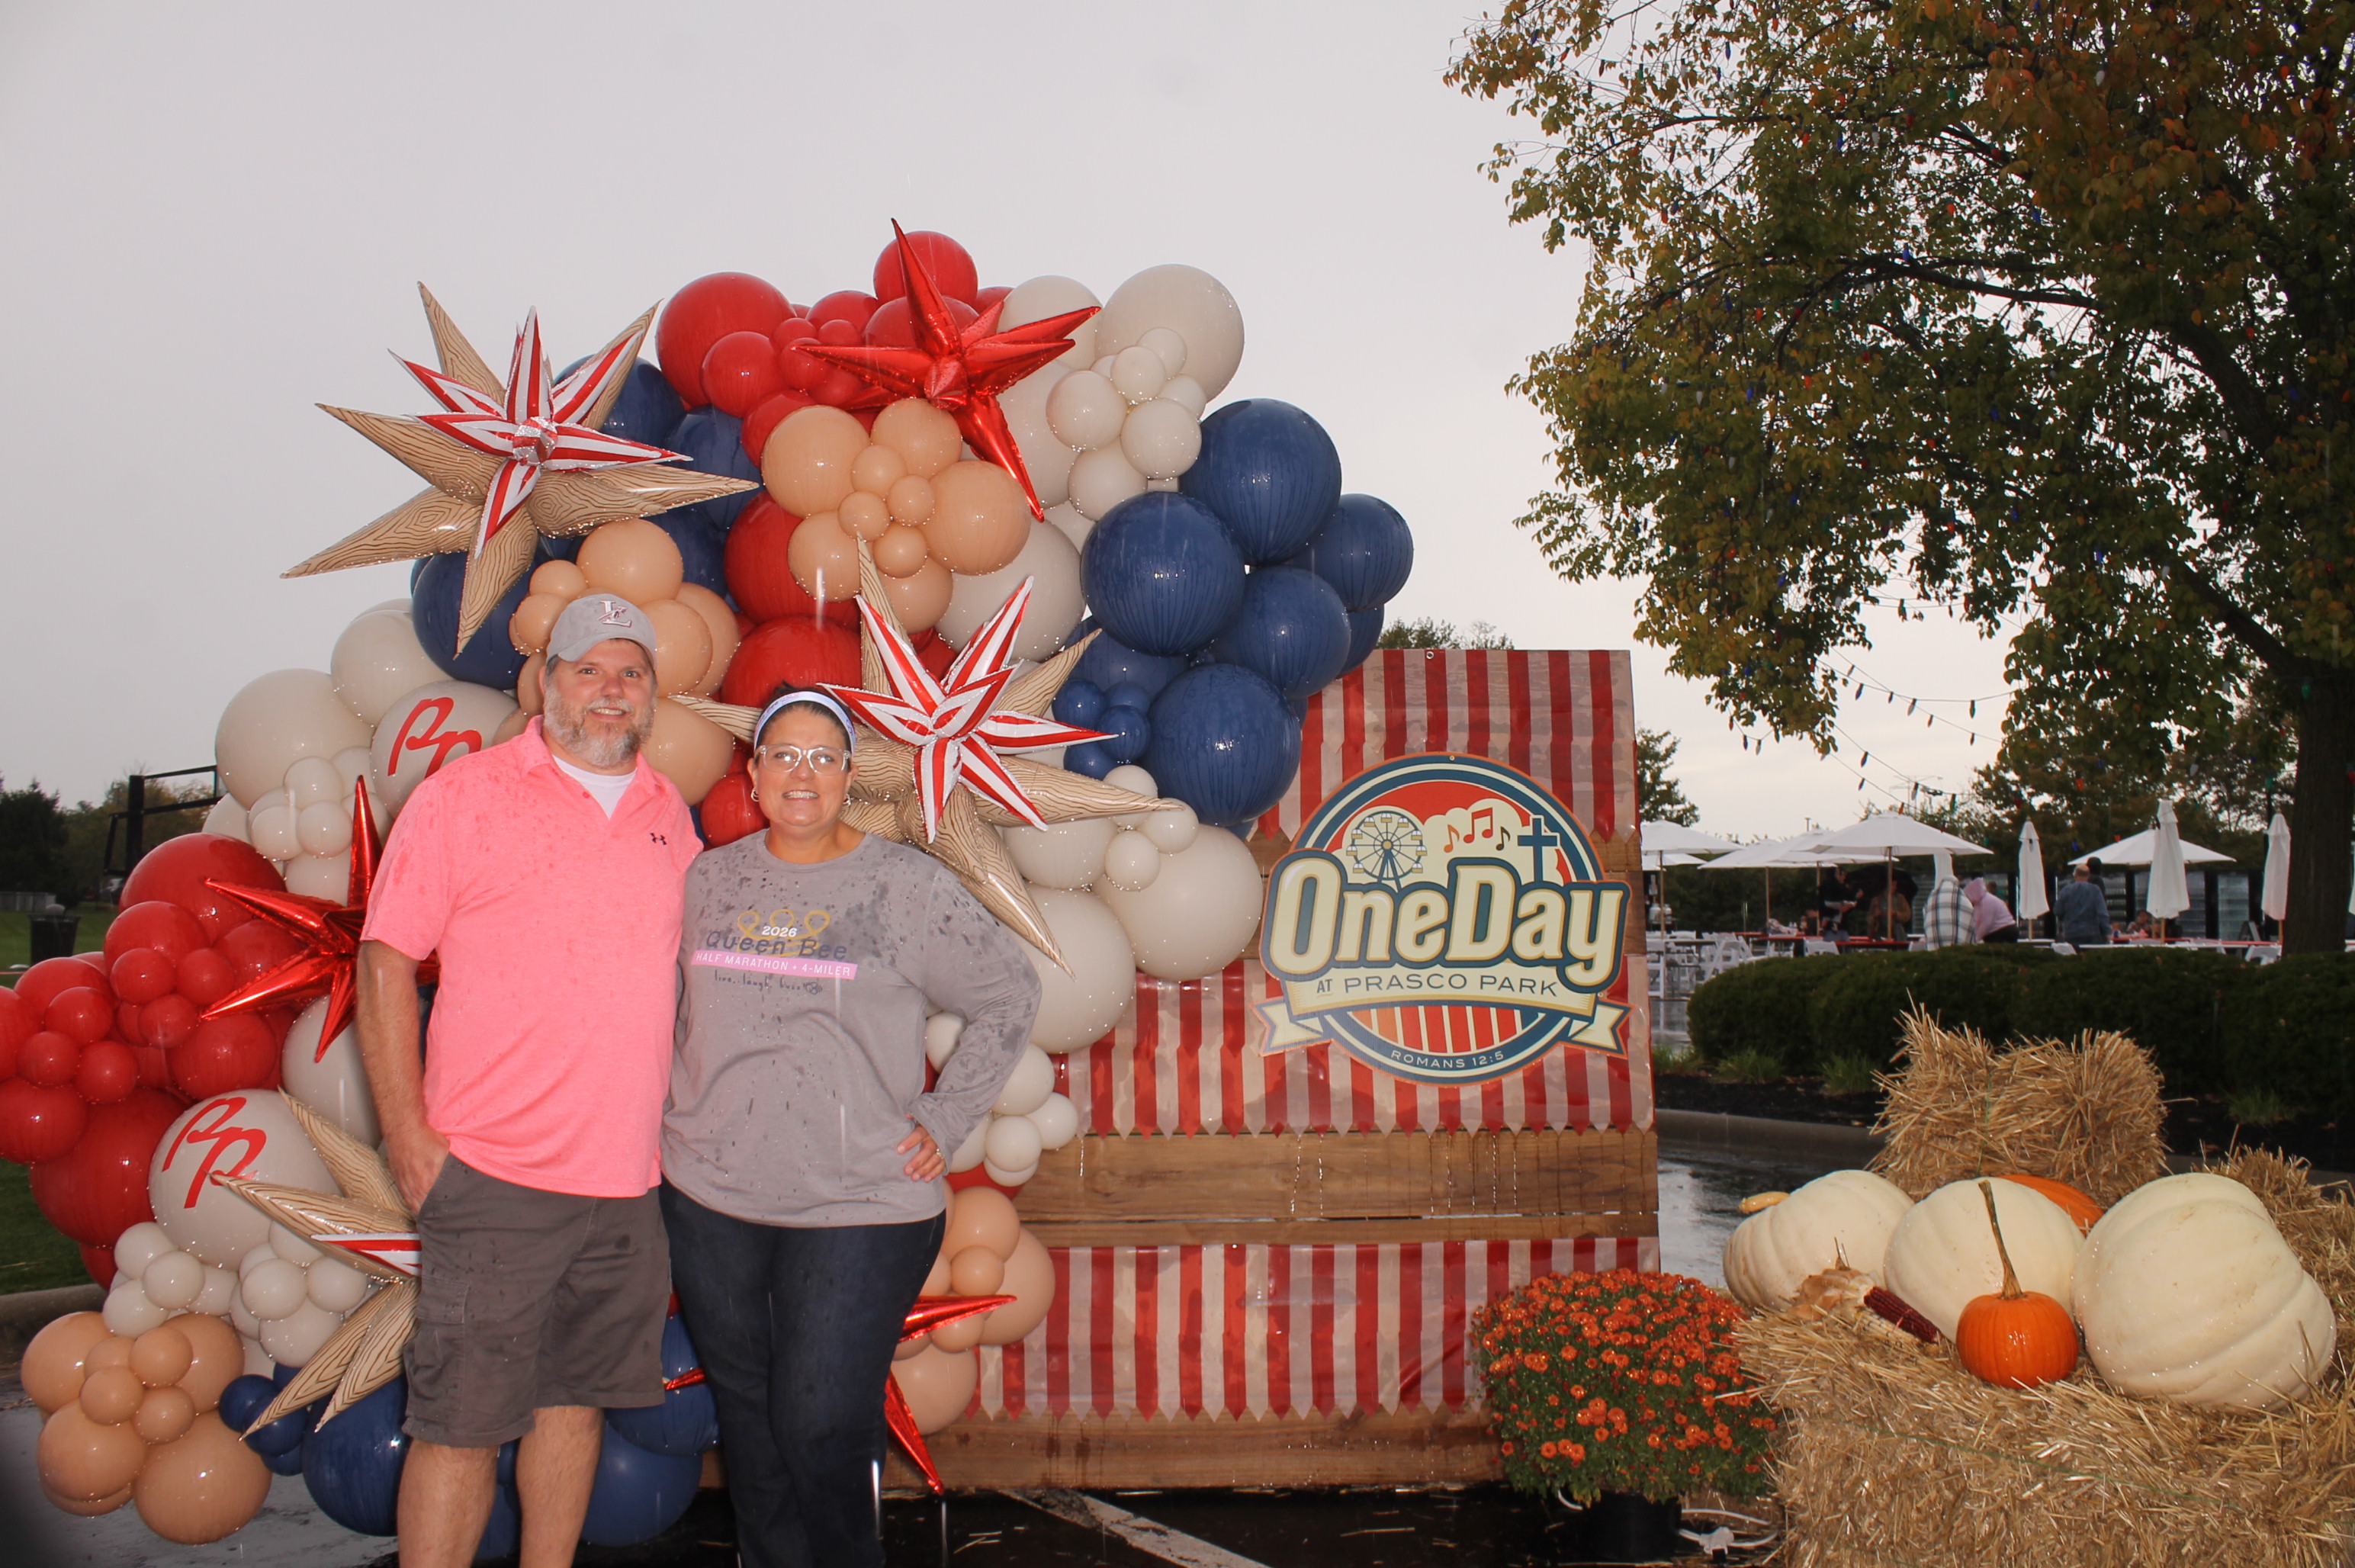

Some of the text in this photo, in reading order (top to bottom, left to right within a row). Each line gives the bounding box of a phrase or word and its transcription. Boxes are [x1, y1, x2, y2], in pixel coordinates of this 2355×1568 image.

[762, 925, 798, 938] 2026
[1267, 860, 1625, 988] OneDay
[706, 930, 848, 960] Queen Bee
[696, 953, 722, 963] HALF
[724, 955, 789, 971] MARATHON
[802, 962, 851, 977] 4-MILER
[1316, 973, 1558, 998] AT PRASCO PARK
[1390, 1049, 1505, 1068] ROMANS 12:5
